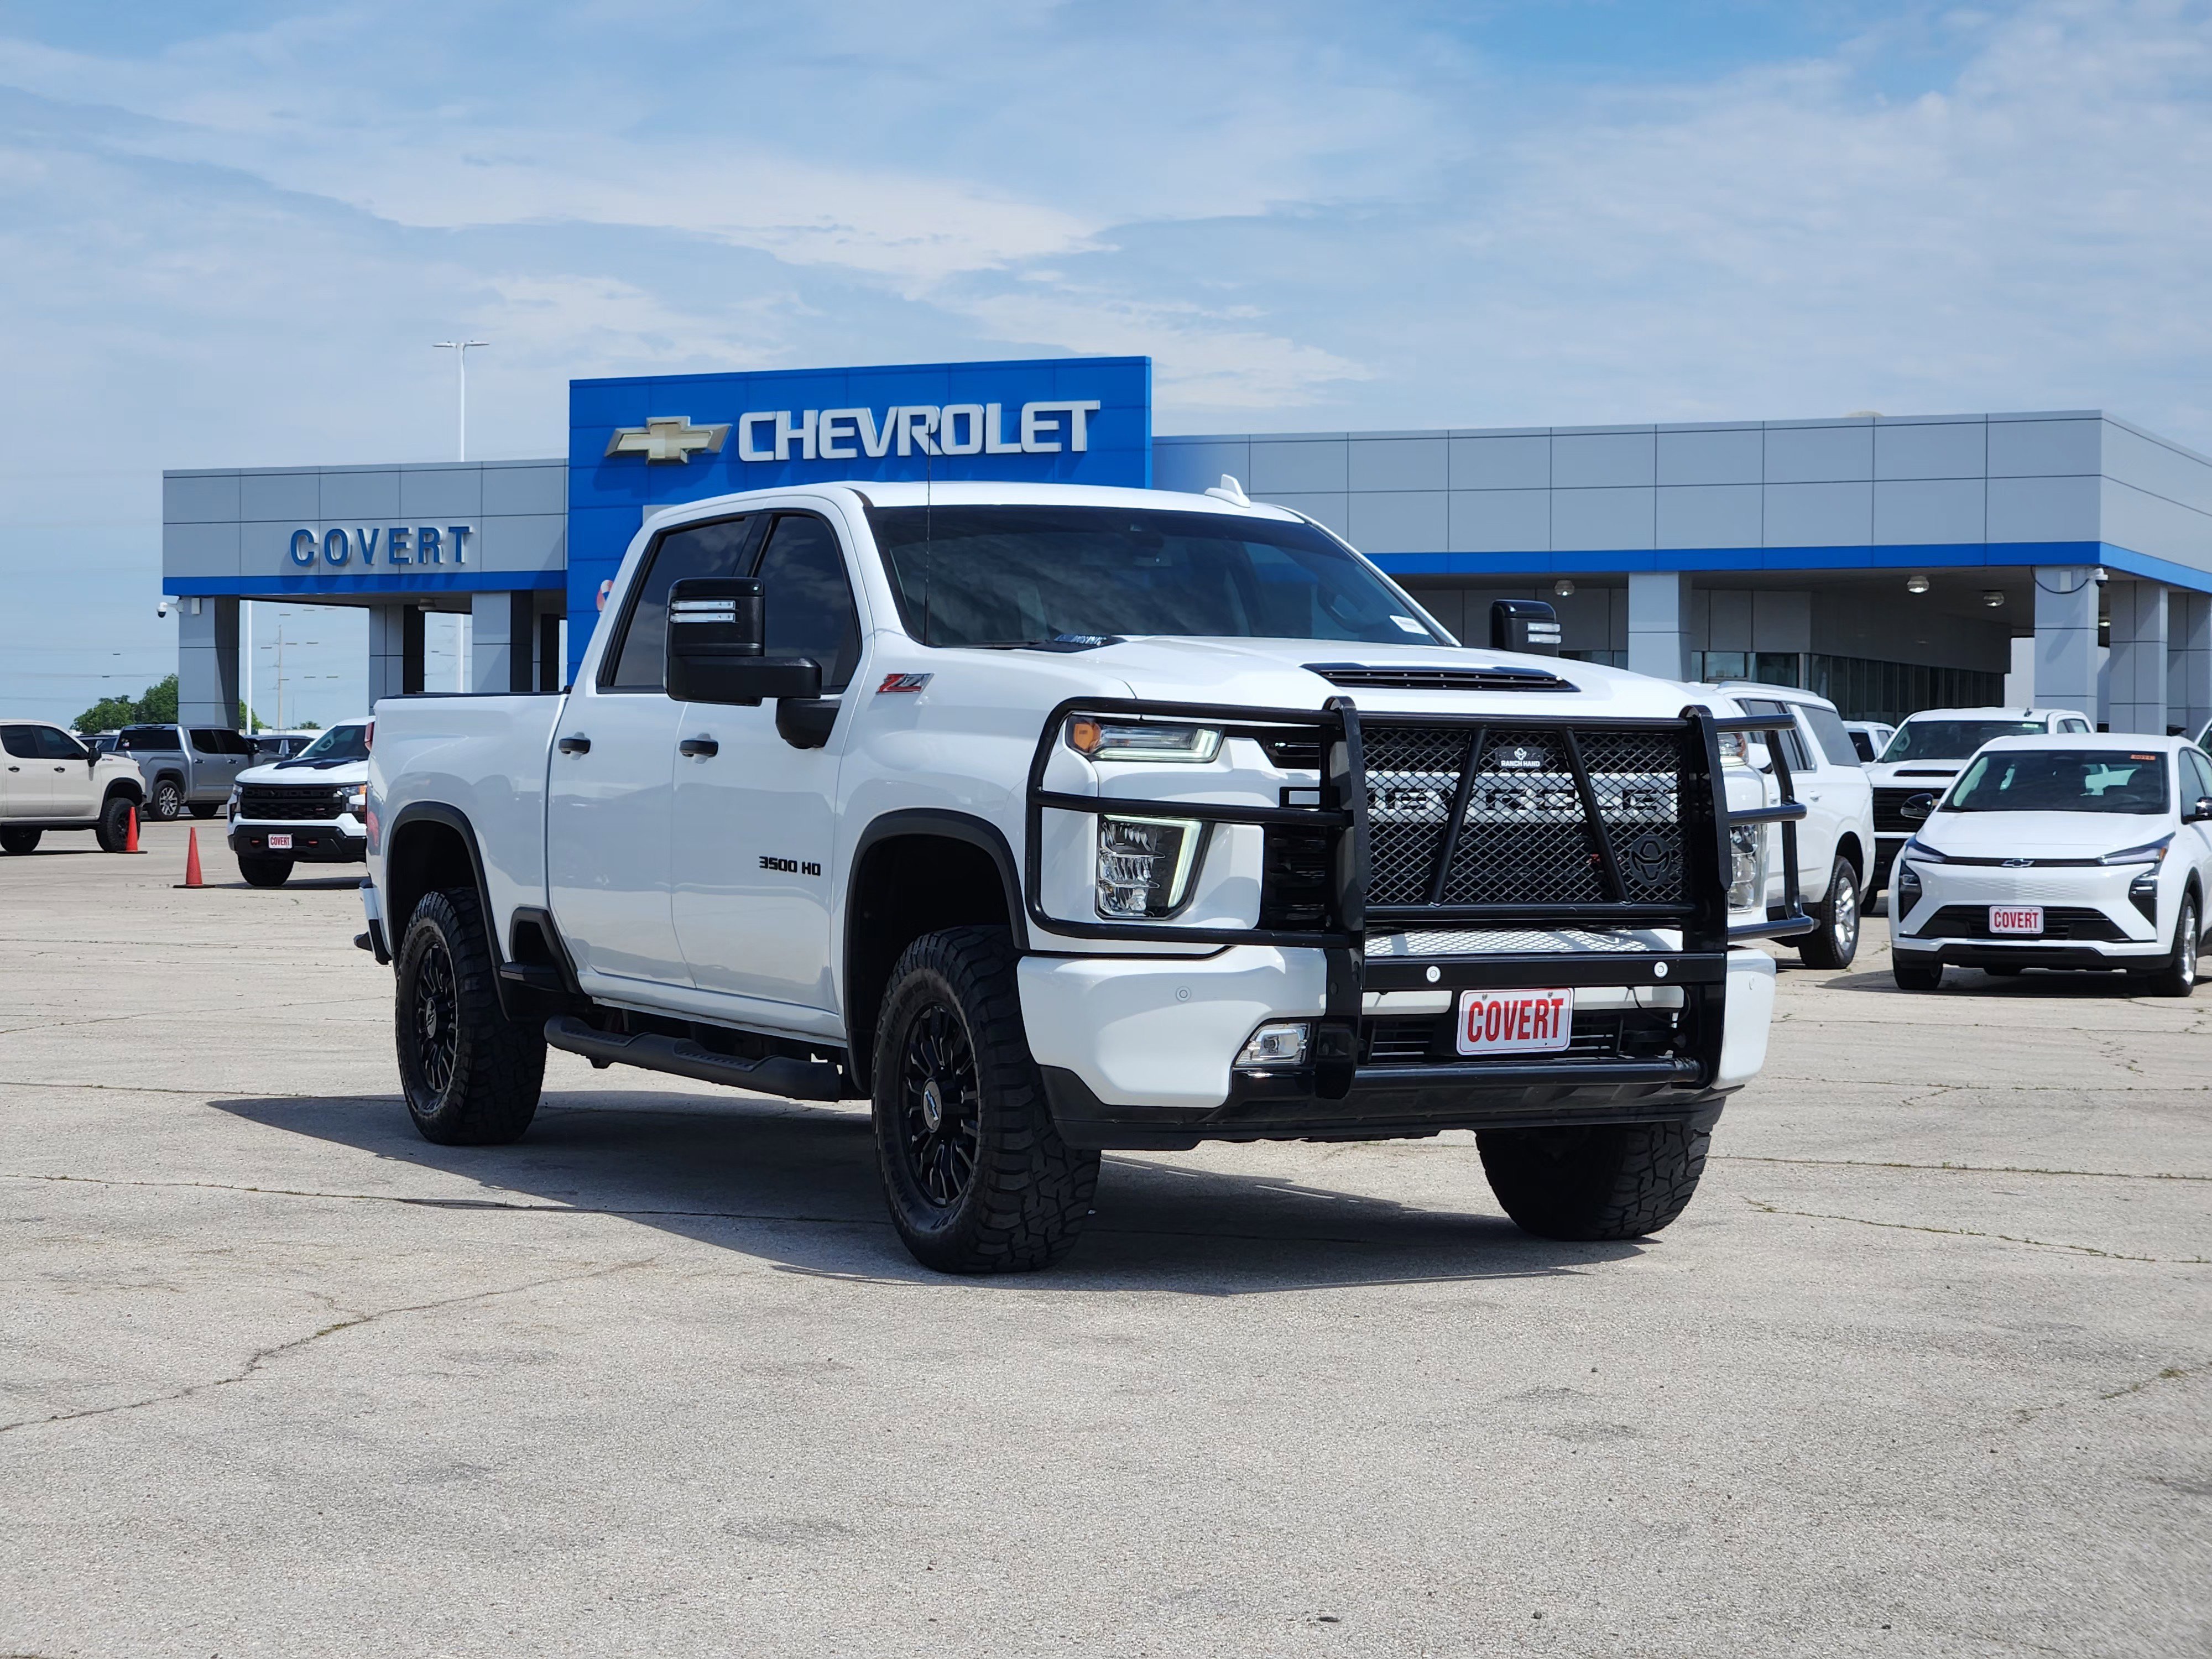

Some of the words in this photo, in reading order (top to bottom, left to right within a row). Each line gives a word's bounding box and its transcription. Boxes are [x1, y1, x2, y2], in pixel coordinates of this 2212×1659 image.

[739, 400, 1100, 462] CHEVROLET
[290, 526, 474, 567] COVERT
[876, 673, 935, 695] Z71
[270, 837, 290, 846] COVERT
[759, 856, 797, 873] 3500
[801, 862, 821, 877] HD
[1994, 911, 2039, 928] COVERT
[1467, 998, 1564, 1042] COVERT
